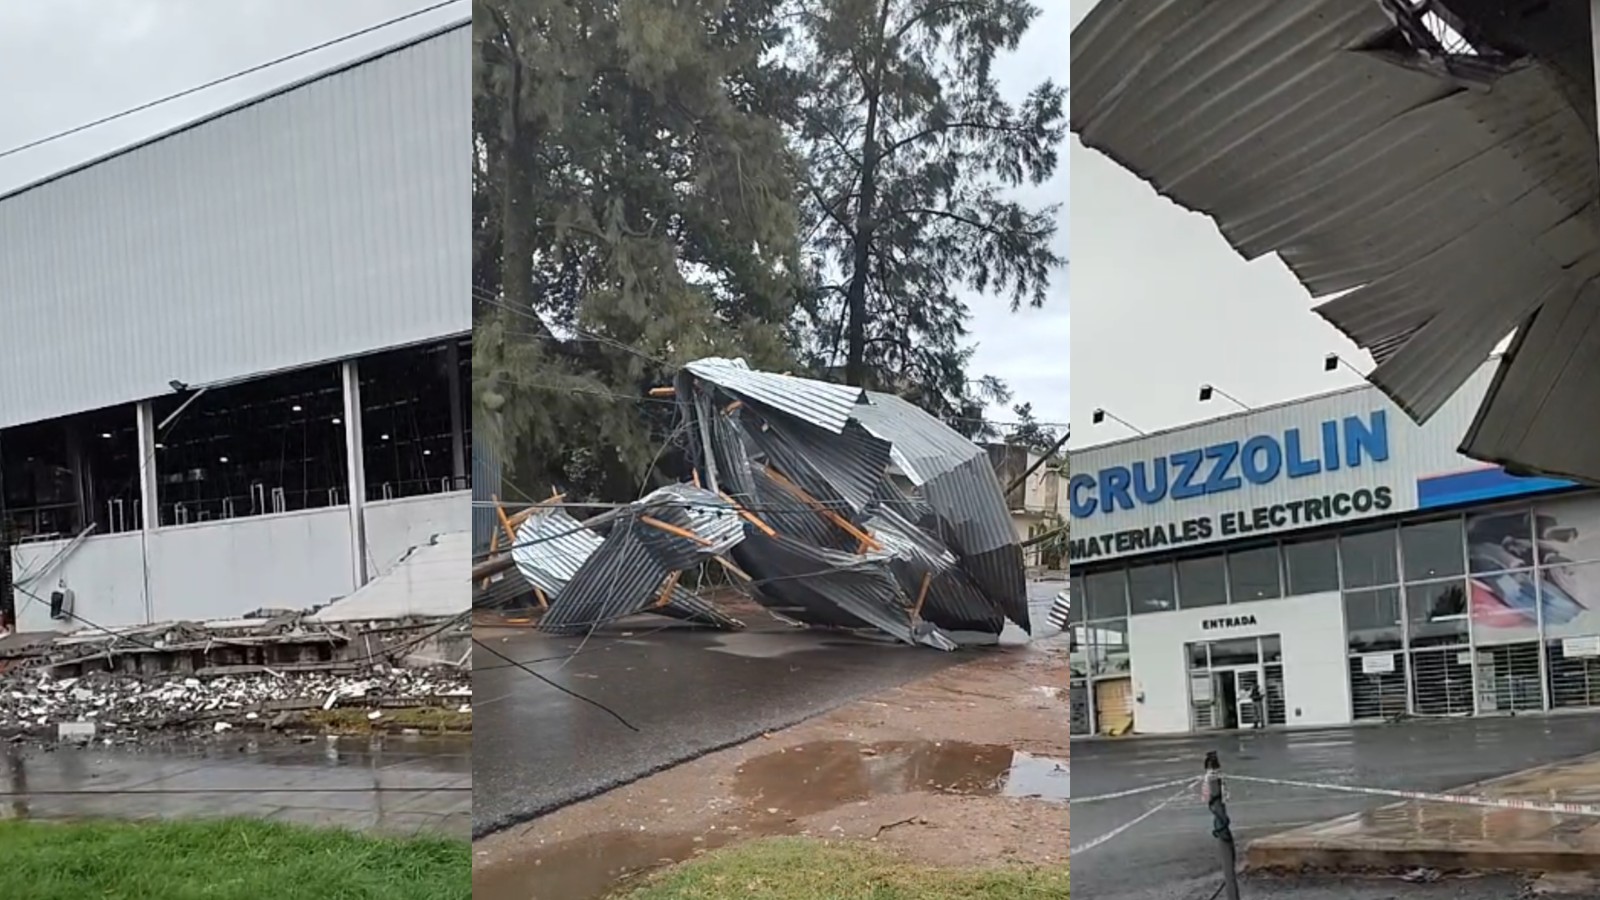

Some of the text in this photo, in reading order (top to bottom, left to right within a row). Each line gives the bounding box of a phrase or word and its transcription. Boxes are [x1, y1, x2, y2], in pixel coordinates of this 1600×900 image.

[1070, 410, 1389, 518] CRUZZOLIN
[1070, 486, 1392, 560] MATERIALES ELECTRICOS
[1202, 614, 1258, 630] ENTRADA
